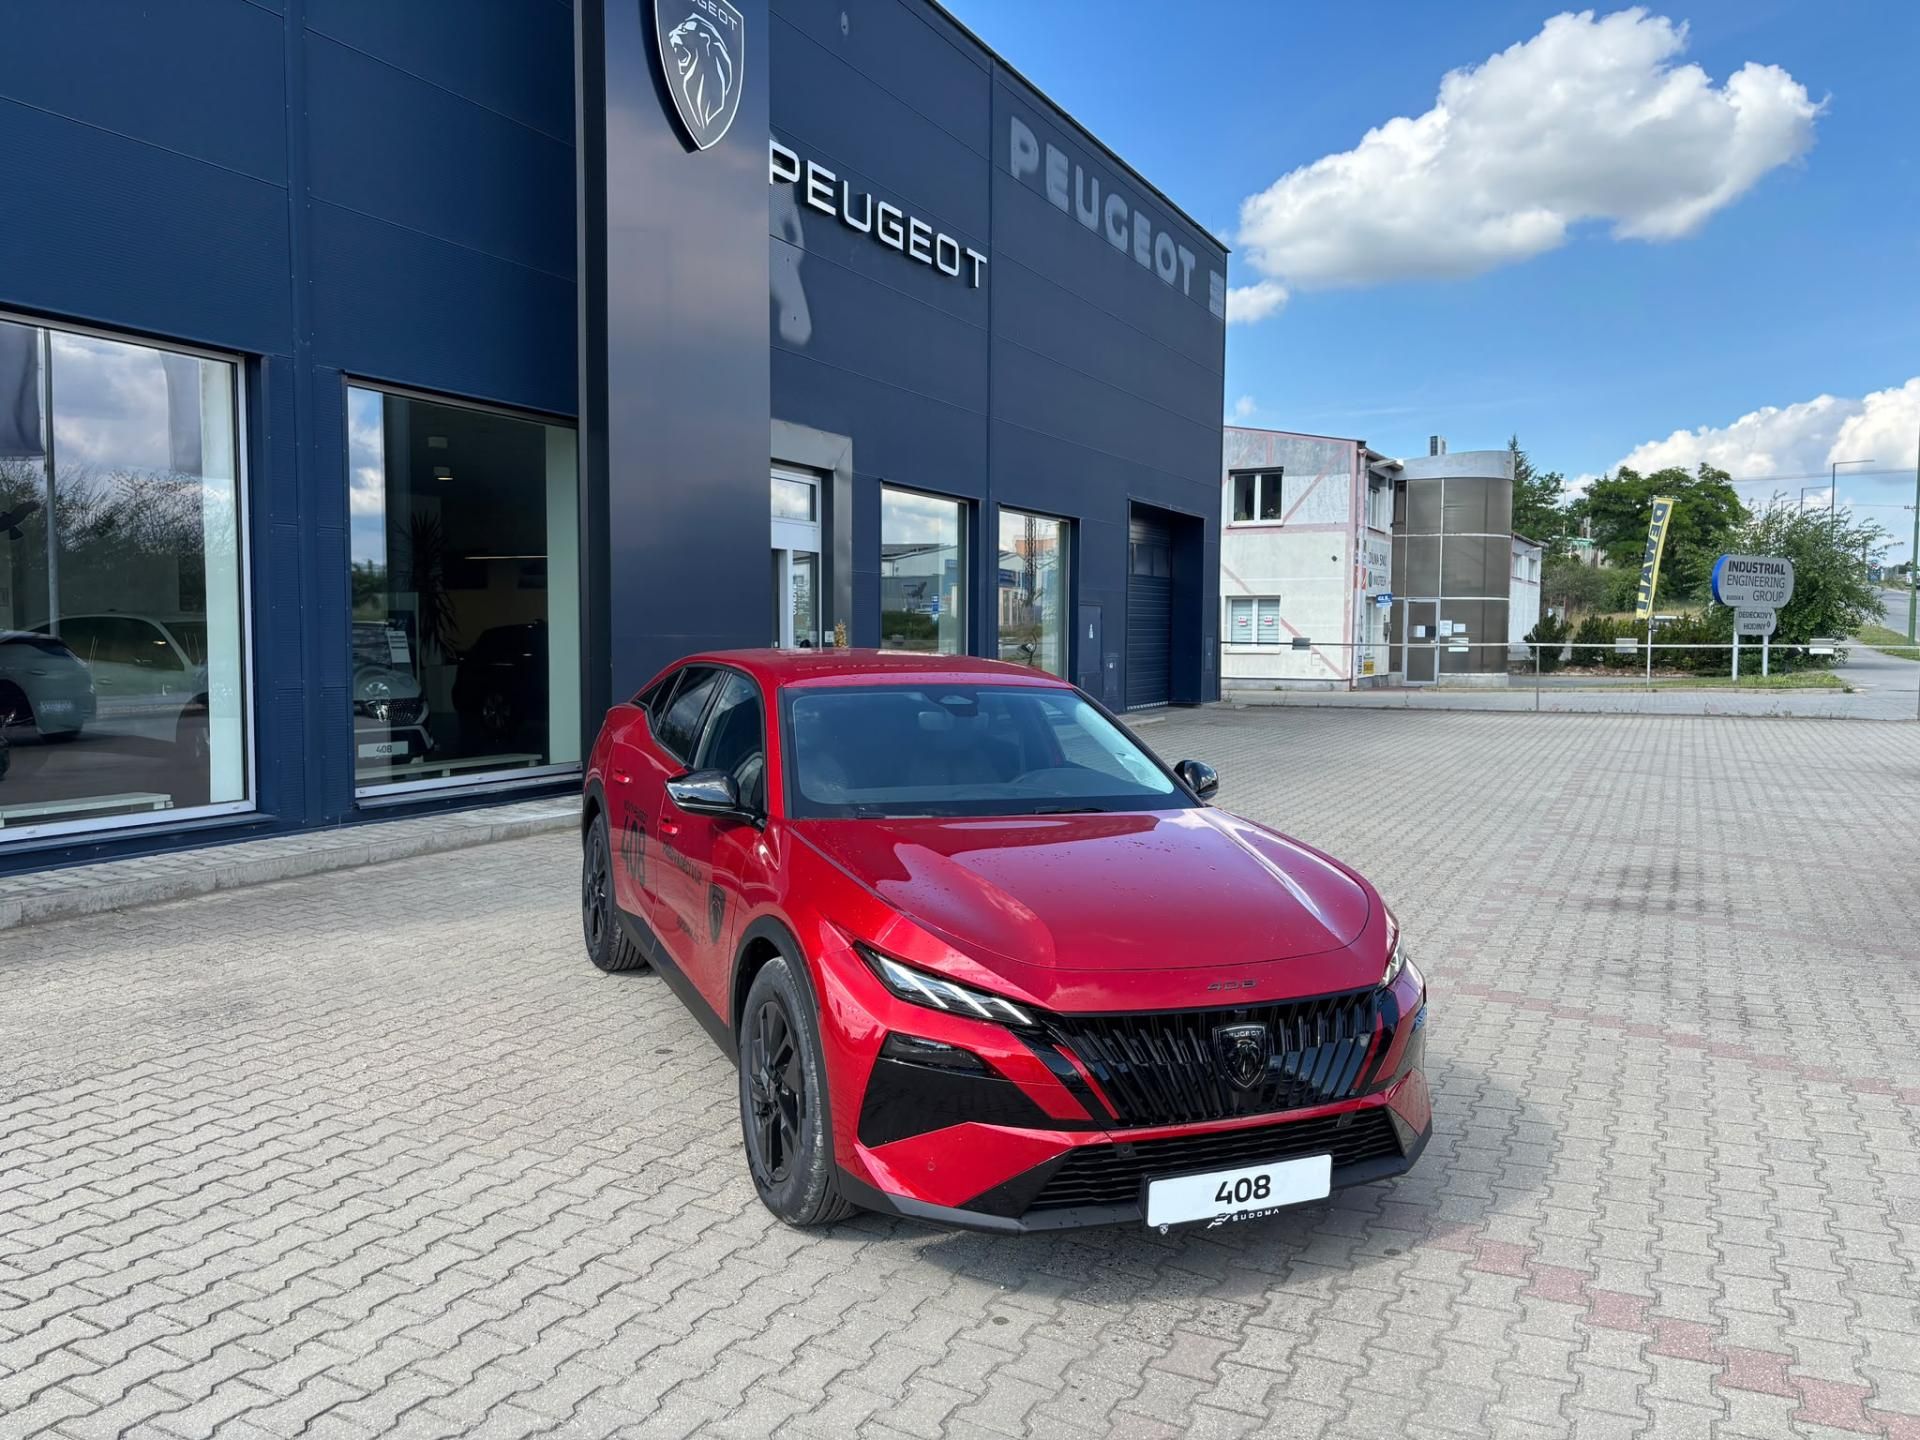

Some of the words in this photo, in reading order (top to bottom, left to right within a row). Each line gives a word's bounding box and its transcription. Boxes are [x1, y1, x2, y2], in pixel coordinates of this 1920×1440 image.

[692, 0, 738, 31] GEOT
[768, 138, 988, 289] PEUGEOT
[1011, 115, 1196, 297] PEUGEOT
[1728, 560, 1786, 576] INDUSTRIAL
[1726, 574, 1785, 589] ENGINEERING
[1752, 590, 1785, 602] GROUP
[376, 744, 393, 754] 408
[621, 815, 646, 889] 408
[1207, 979, 1257, 992] 408
[1214, 1174, 1271, 1206] 408
